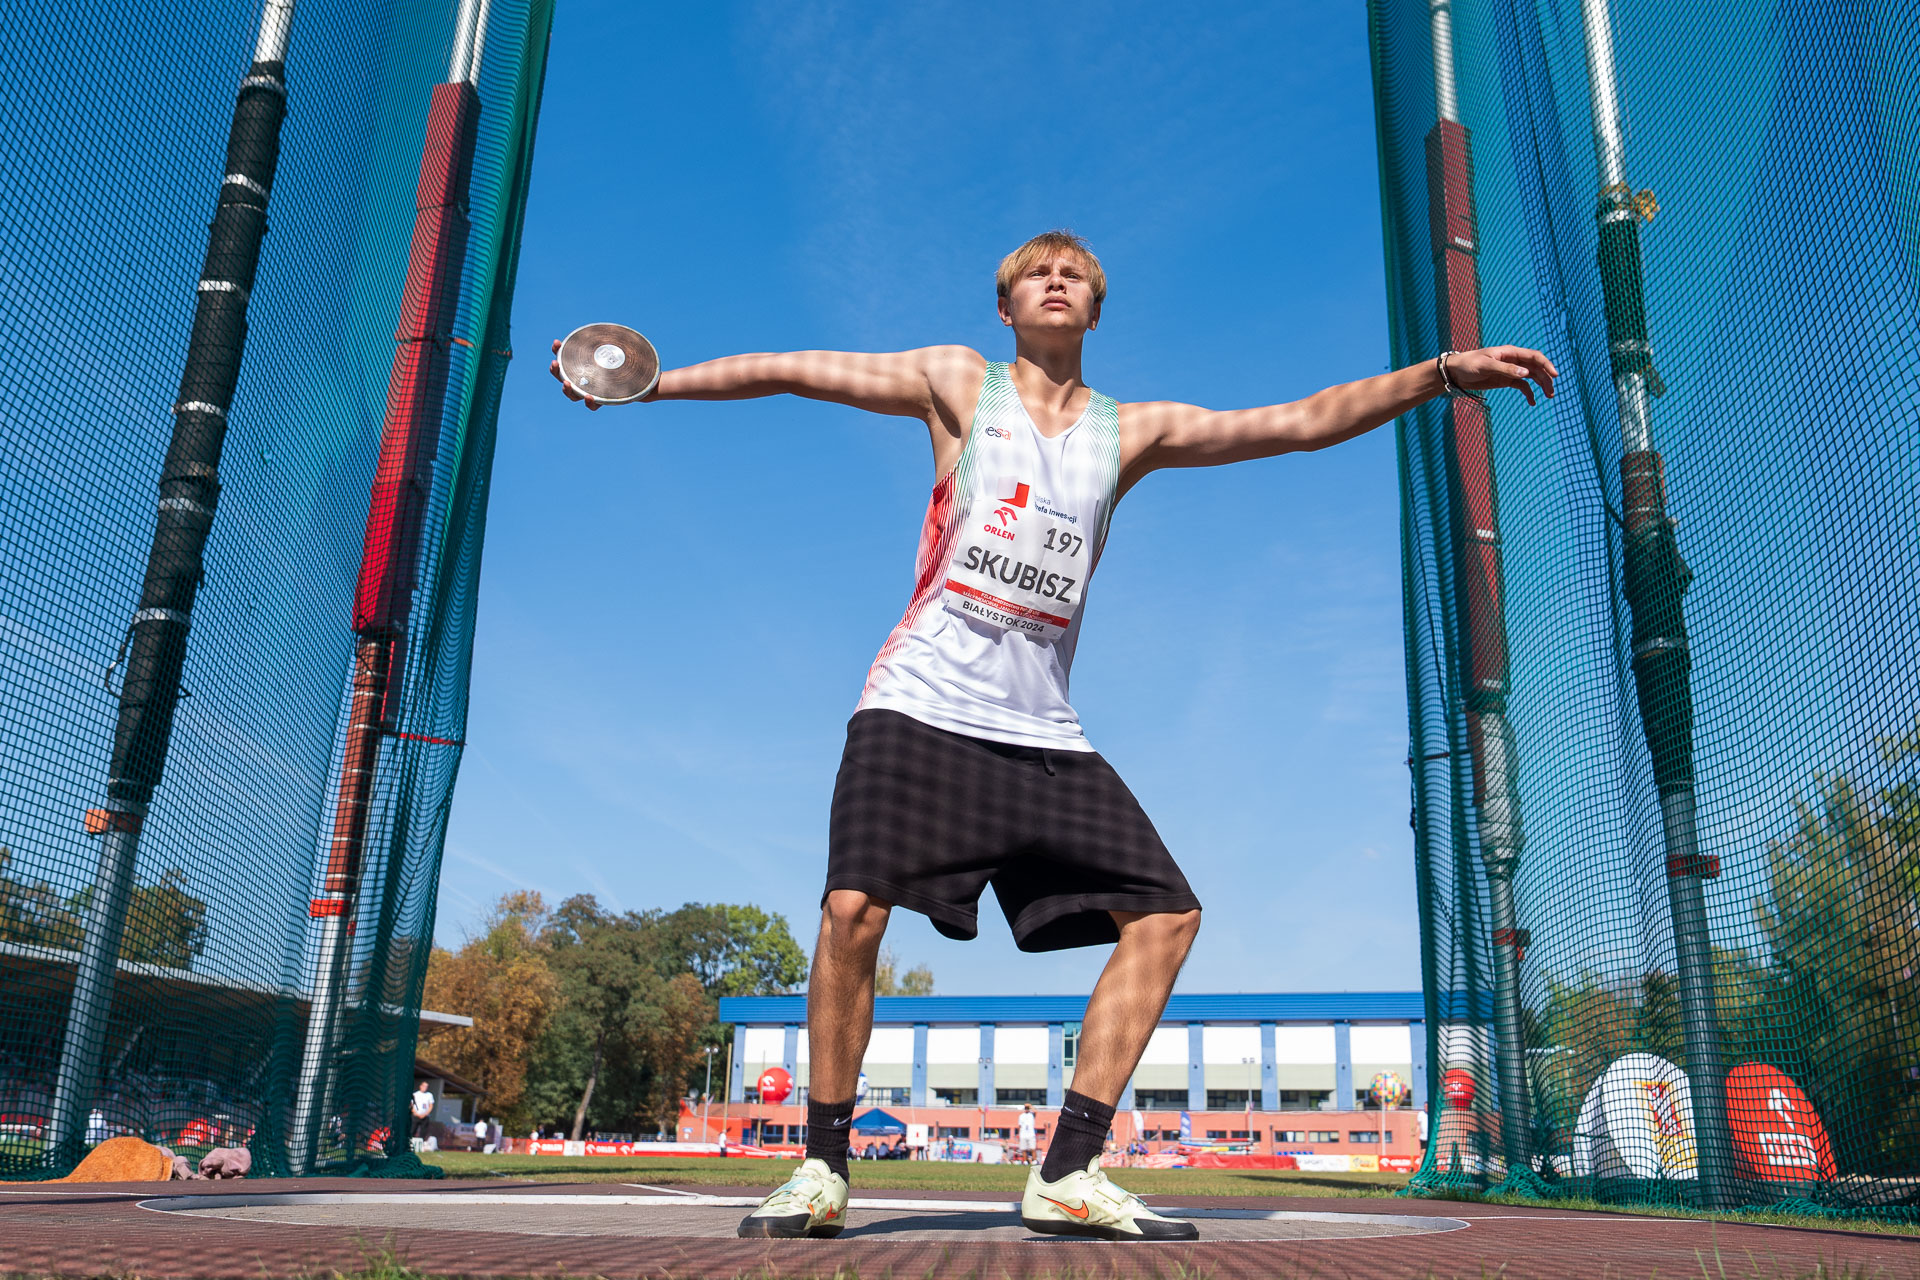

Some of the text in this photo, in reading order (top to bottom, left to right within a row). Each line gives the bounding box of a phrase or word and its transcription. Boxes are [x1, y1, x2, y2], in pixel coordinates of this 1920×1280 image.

[983, 524, 1016, 541] ORLEN
[1043, 527, 1083, 558] 197
[963, 545, 1076, 604] SKUBISZ
[962, 600, 1020, 628] BIAŁYSTOK
[1020, 620, 1045, 633] 2024
